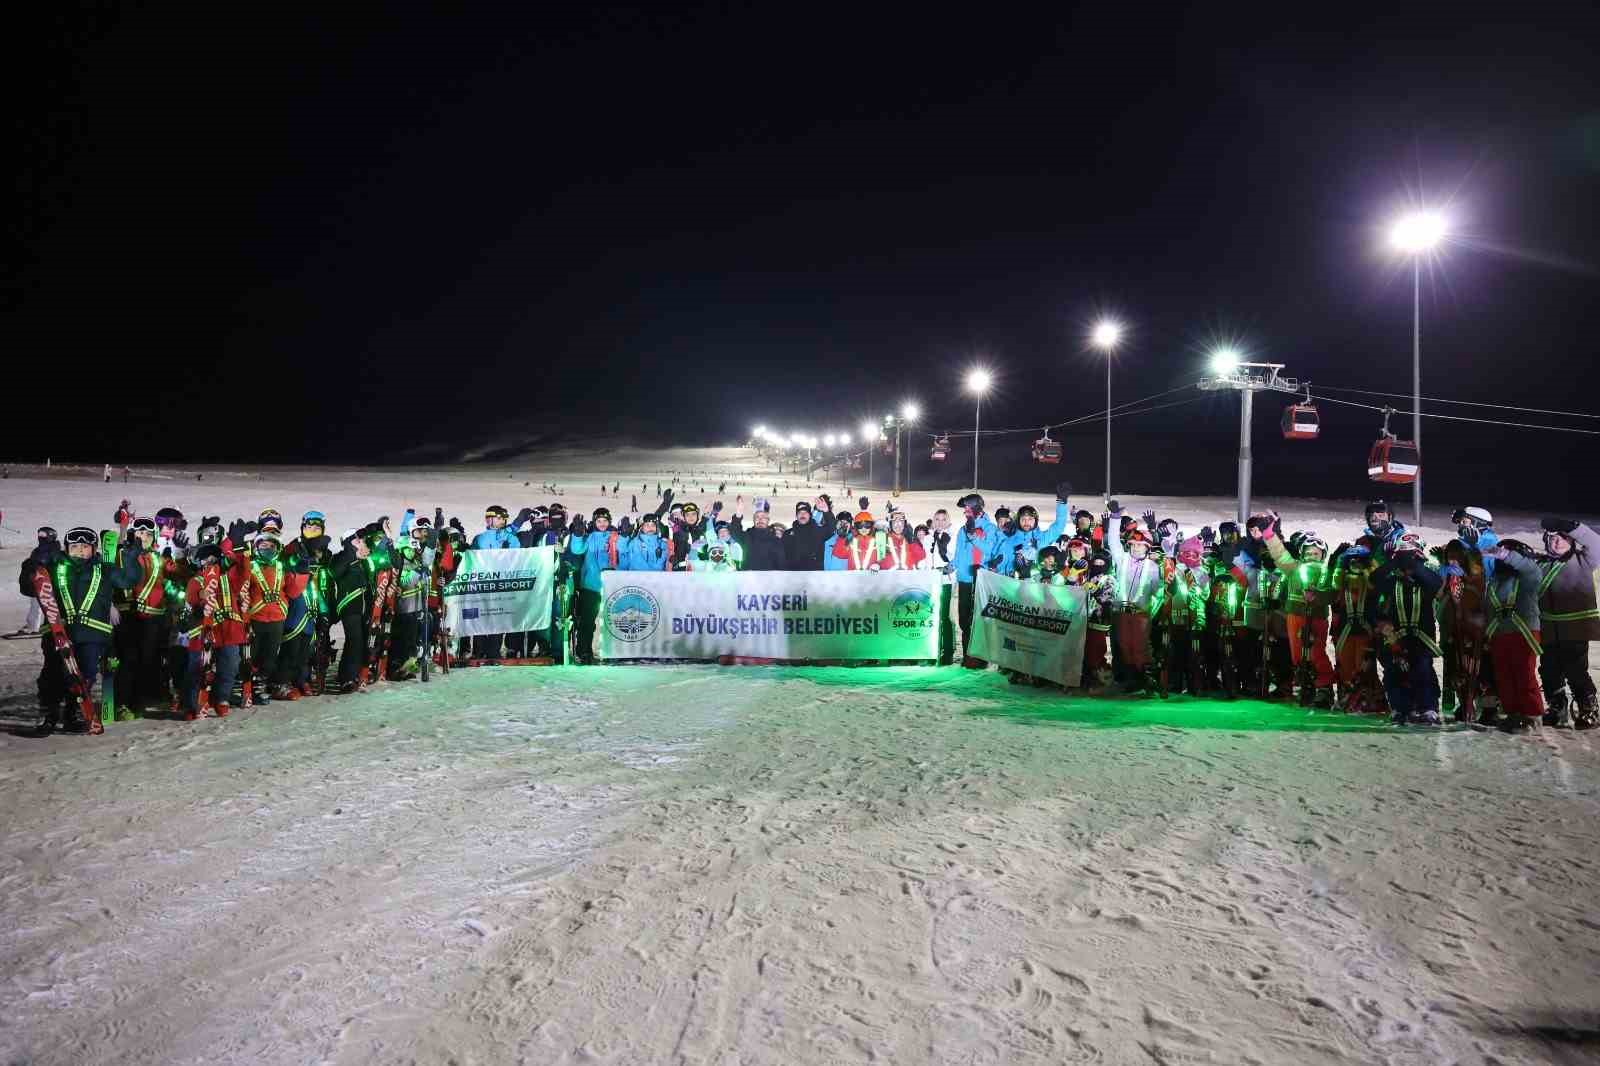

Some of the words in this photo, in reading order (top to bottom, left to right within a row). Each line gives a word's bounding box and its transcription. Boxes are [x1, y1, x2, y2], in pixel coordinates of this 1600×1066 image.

[501, 568, 537, 580] WEEK
[456, 582, 497, 593] WINTER
[498, 580, 531, 591] SPORT
[737, 590, 808, 611] KAYSERİ
[671, 613, 778, 639] BÜYÜKŞEHİR
[783, 613, 879, 635] BELEDİYESİ
[892, 620, 916, 629] SPOR
